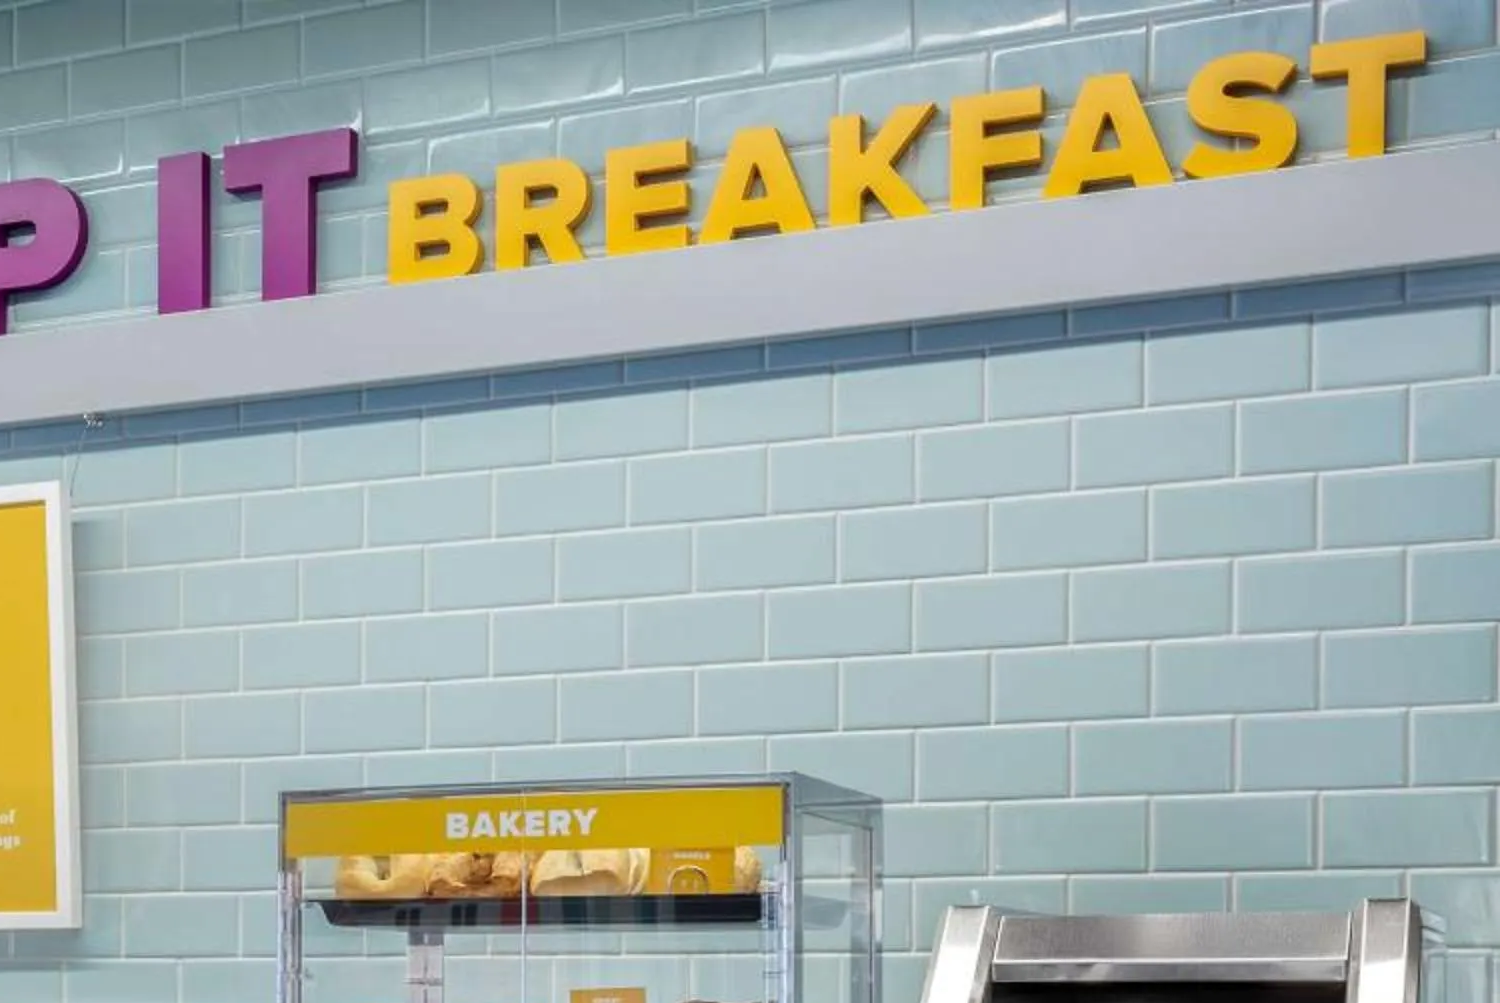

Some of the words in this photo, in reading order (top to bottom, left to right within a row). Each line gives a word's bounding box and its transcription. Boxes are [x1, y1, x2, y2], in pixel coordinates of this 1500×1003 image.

[387, 31, 1426, 284] BREAKFAST
[158, 128, 358, 314] IT
[0, 808, 17, 825] of
[445, 807, 599, 840] BAKERY
